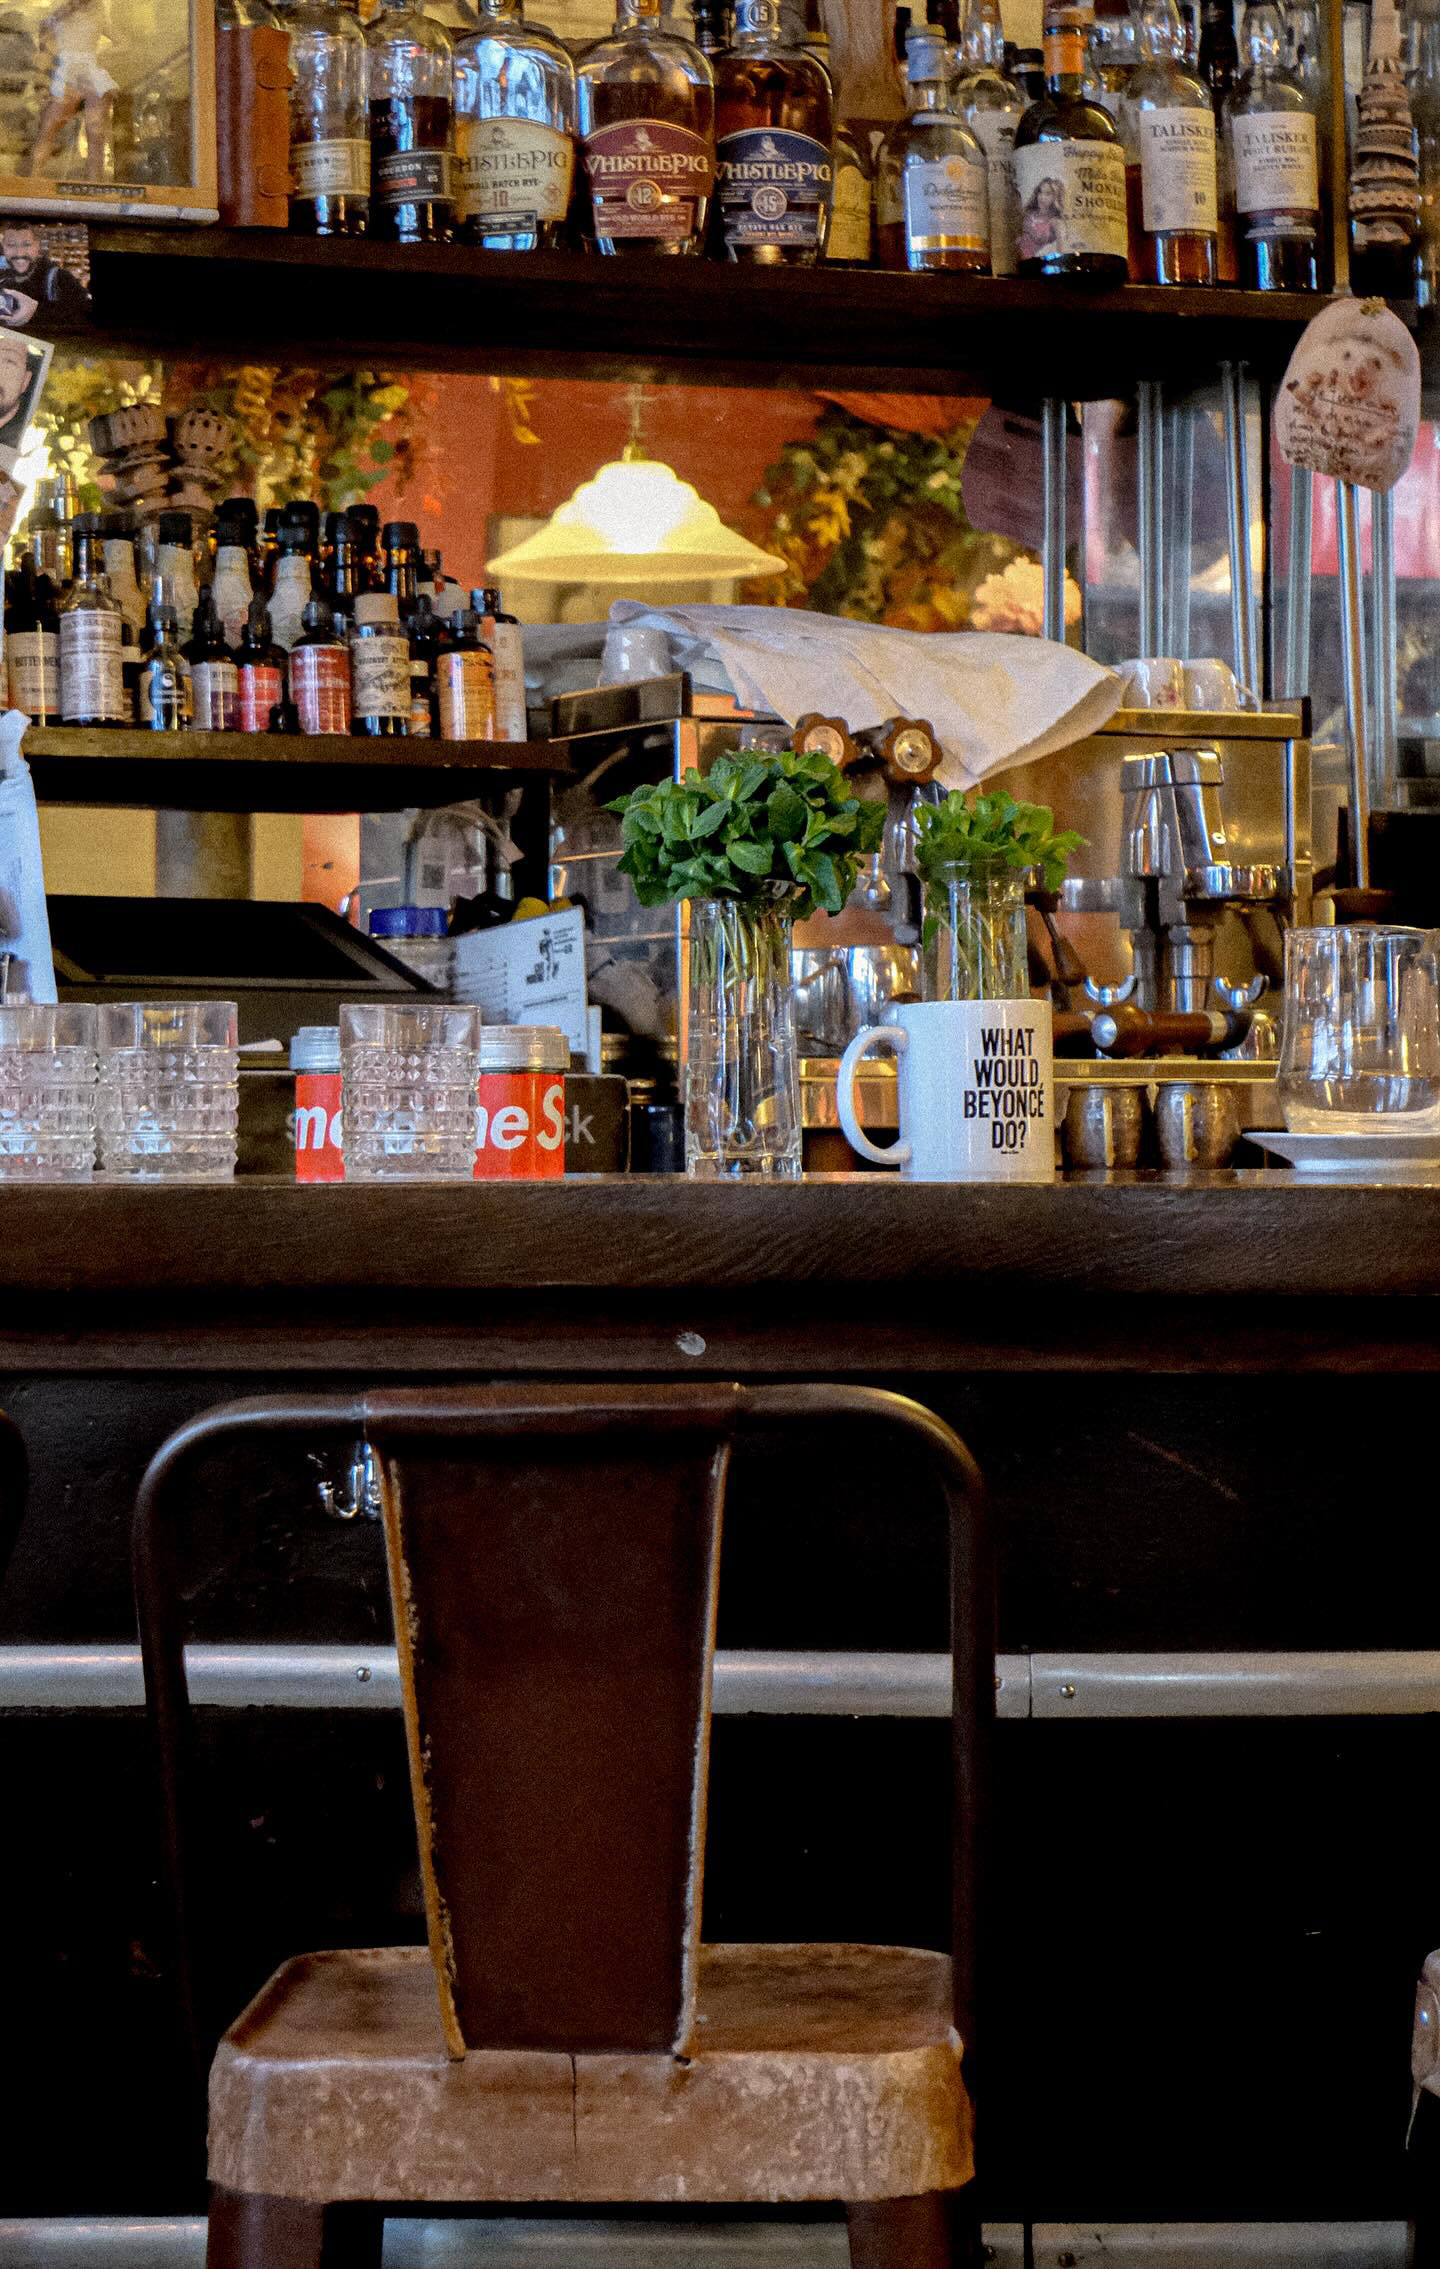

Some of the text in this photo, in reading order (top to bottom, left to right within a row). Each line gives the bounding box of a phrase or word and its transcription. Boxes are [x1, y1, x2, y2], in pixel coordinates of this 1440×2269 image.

[493, 190, 509, 208] 10
[637, 187, 651, 205] 12
[762, 194, 777, 213] 15
[981, 1028, 1034, 1056] WHAT
[974, 1059, 1038, 1087] WOULD
[964, 1082, 1044, 1118] BEYONCÉ
[992, 1120, 1026, 1149] DO?
